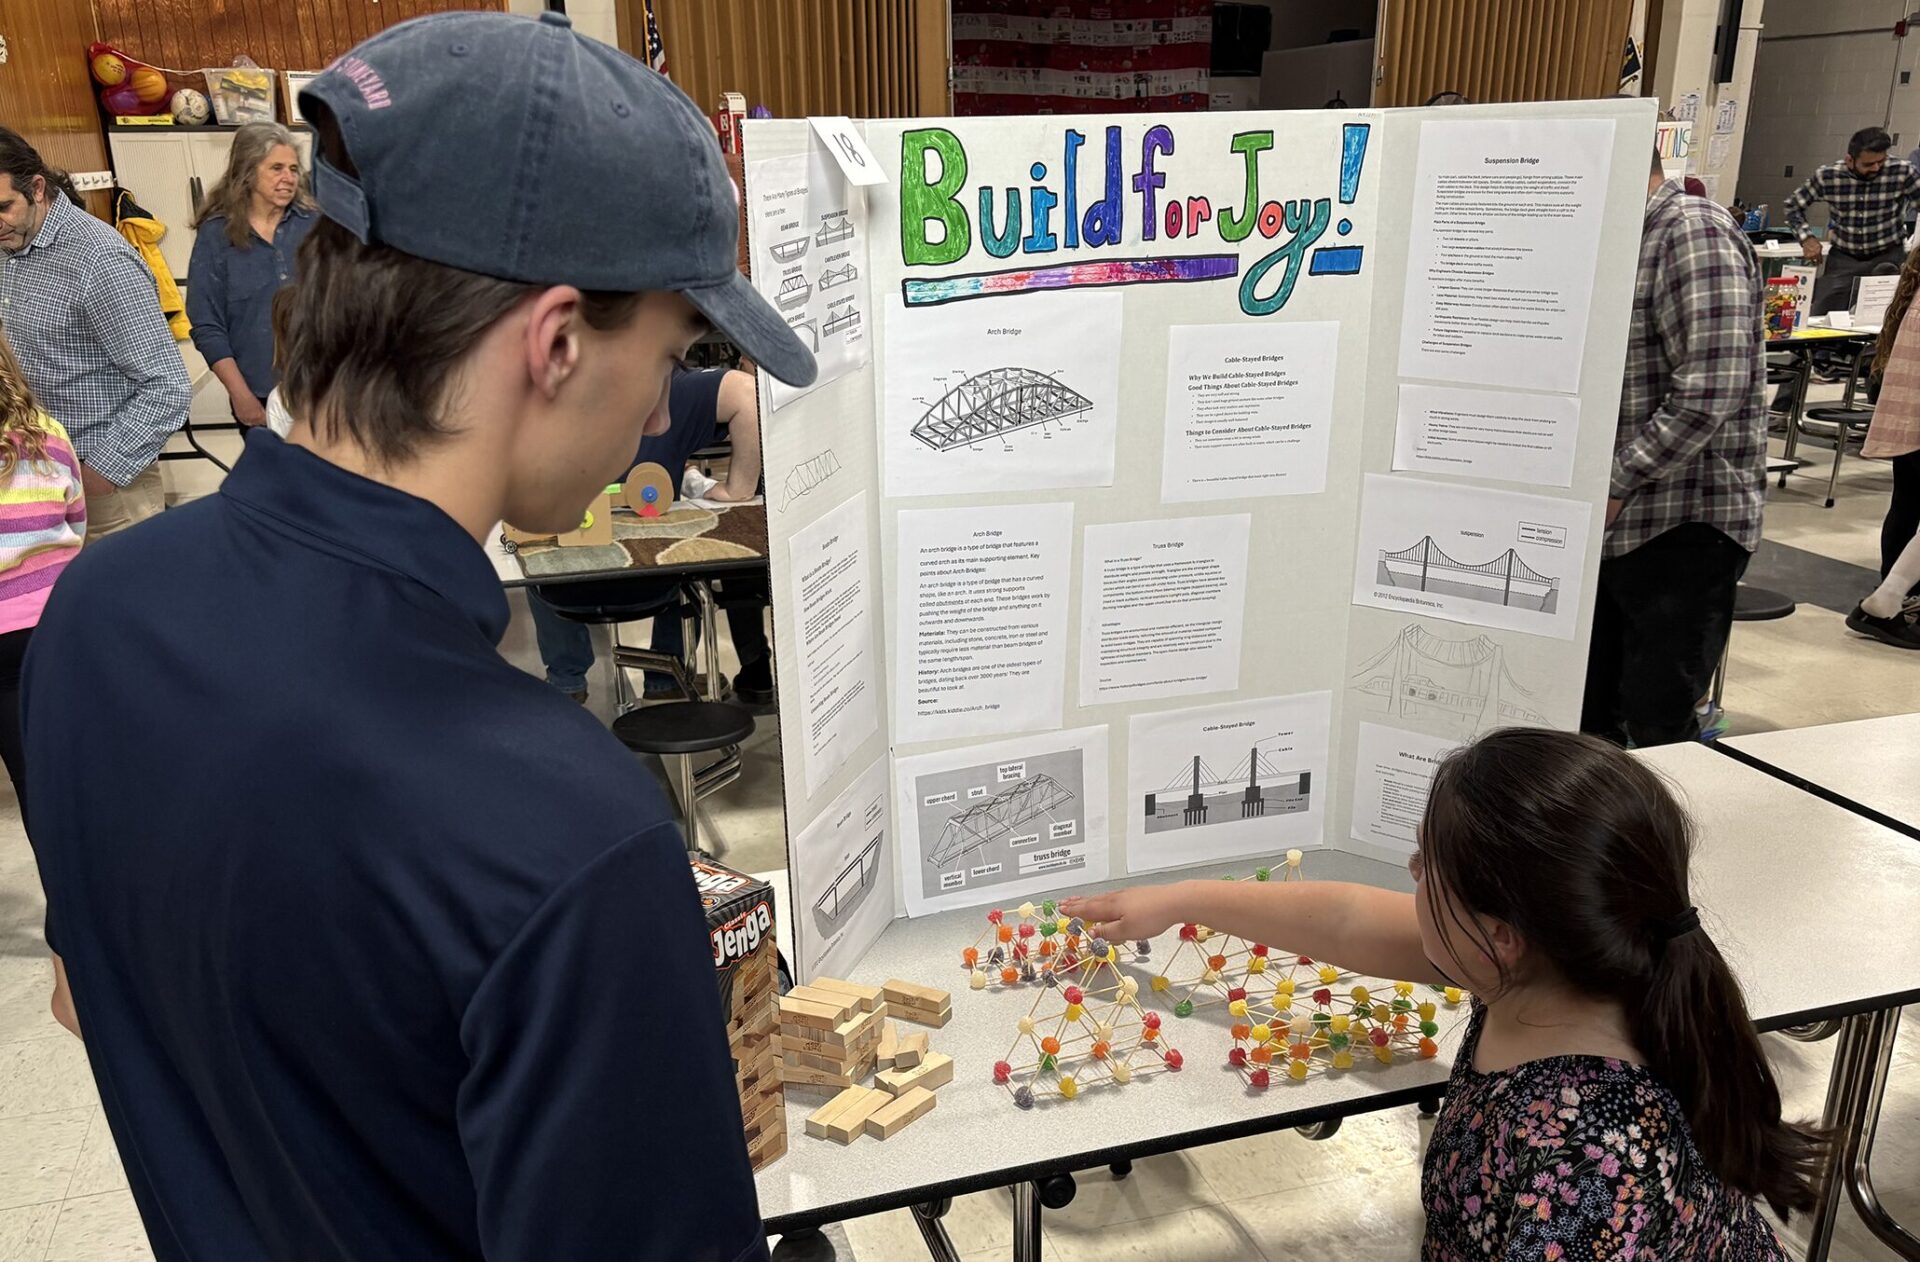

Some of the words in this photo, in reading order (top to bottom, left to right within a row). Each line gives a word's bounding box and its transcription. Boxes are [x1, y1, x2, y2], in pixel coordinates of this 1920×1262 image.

[833, 133, 865, 167] 18
[900, 125, 1122, 266] Build
[1133, 125, 1212, 240] for
[1217, 123, 1370, 316] Joy!
[1224, 356, 1261, 364] Cable-Stayed
[1228, 371, 1264, 380] Cable-Stayed
[1241, 381, 1276, 389] Cable-Stayed
[1254, 424, 1290, 432] Cable-Stayed
[1203, 723, 1238, 732] Cable-Stayed
[1033, 852, 1049, 862] truss
[1051, 848, 1071, 859] bridge
[714, 904, 771, 967] Jenga
